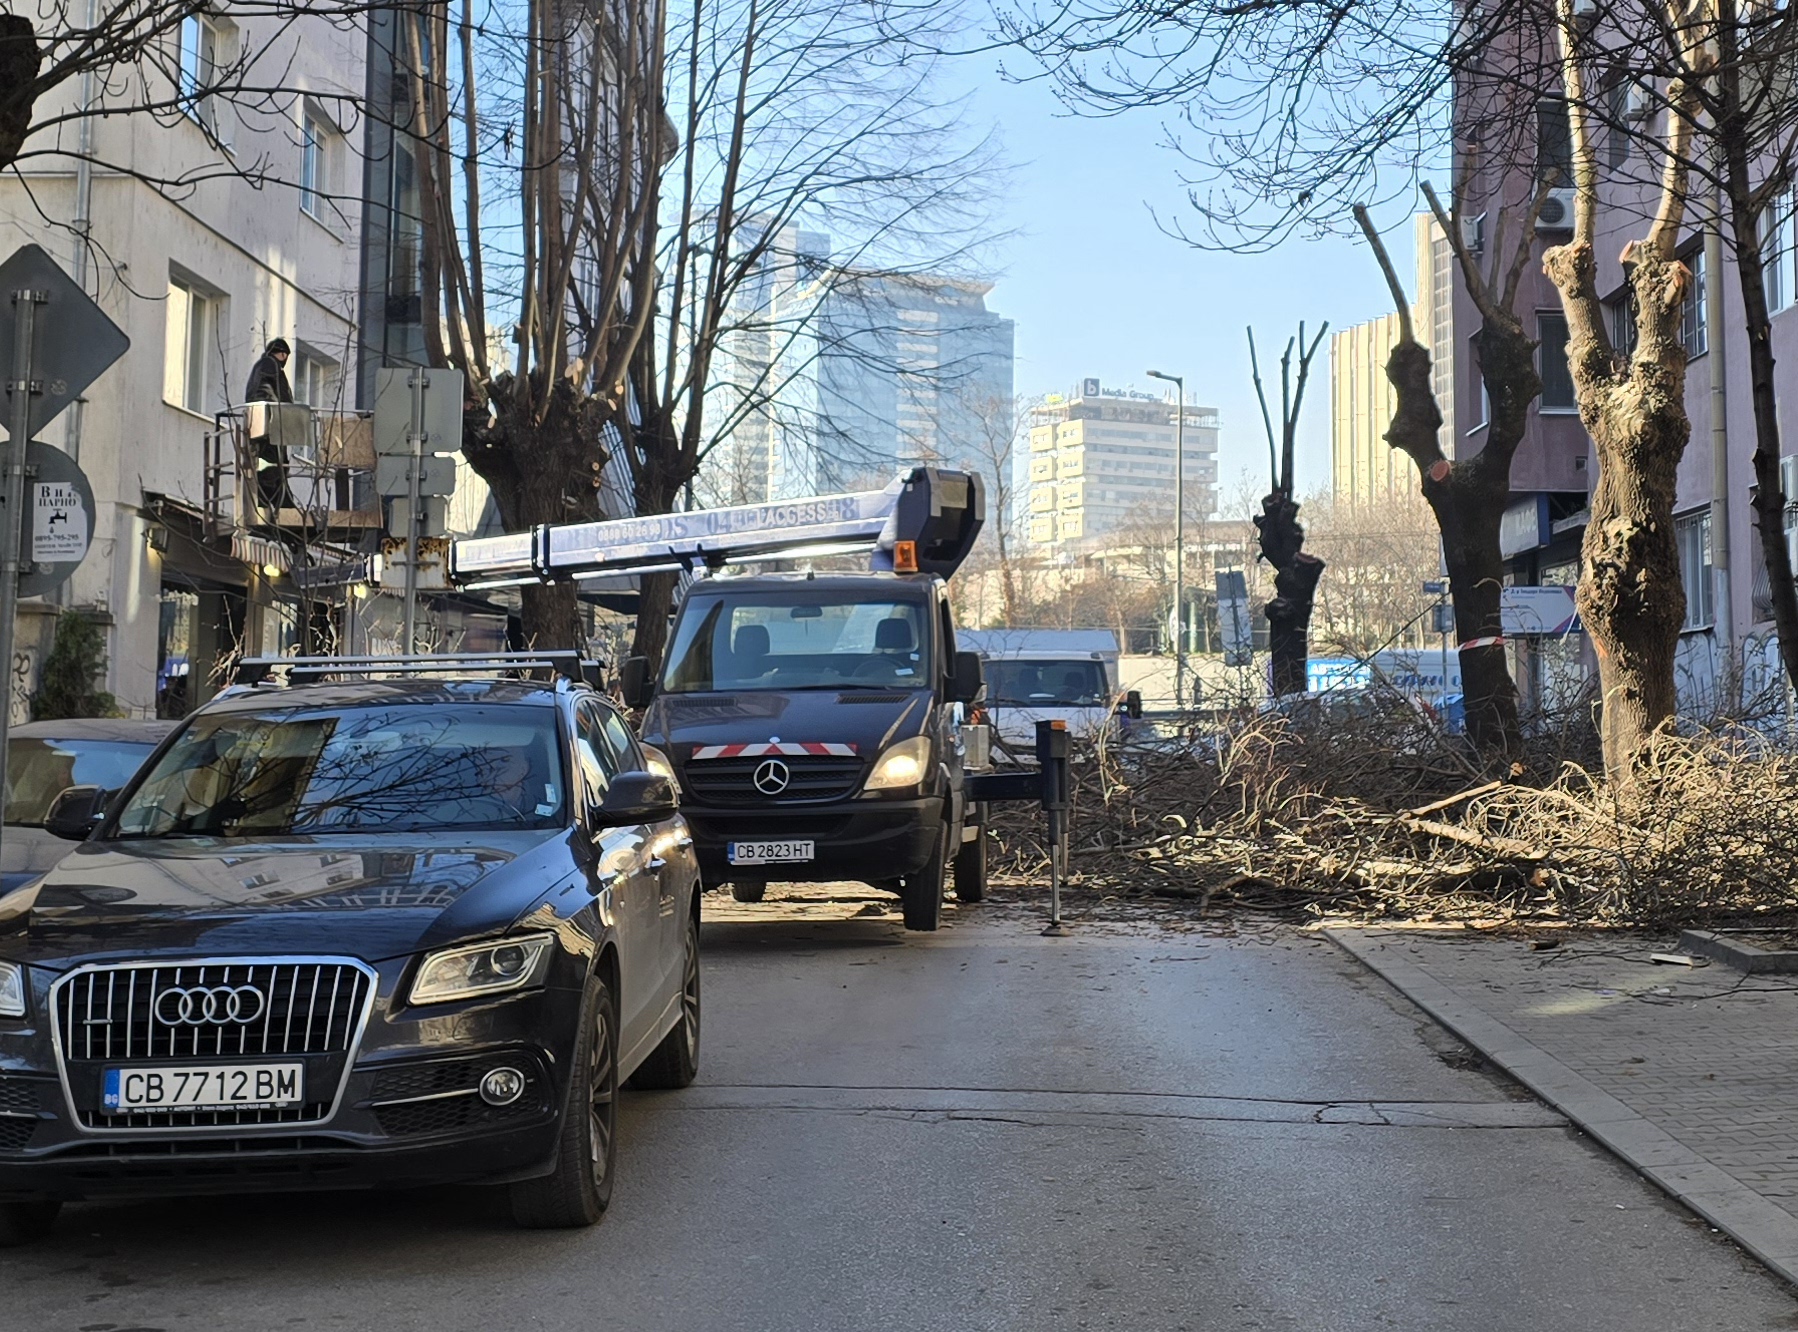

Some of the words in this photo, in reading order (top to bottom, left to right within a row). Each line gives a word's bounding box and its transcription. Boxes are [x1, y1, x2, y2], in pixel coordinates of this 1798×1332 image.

[1102, 388, 1127, 398] Media
[1129, 390, 1154, 402] Group
[39, 498, 77, 507] ПАРНО
[738, 845, 755, 858] CB
[758, 843, 791, 858] 2823
[793, 843, 811, 857] HT
[125, 1074, 164, 1104] CB
[173, 1070, 248, 1103] 7712
[256, 1069, 296, 1100] BM
